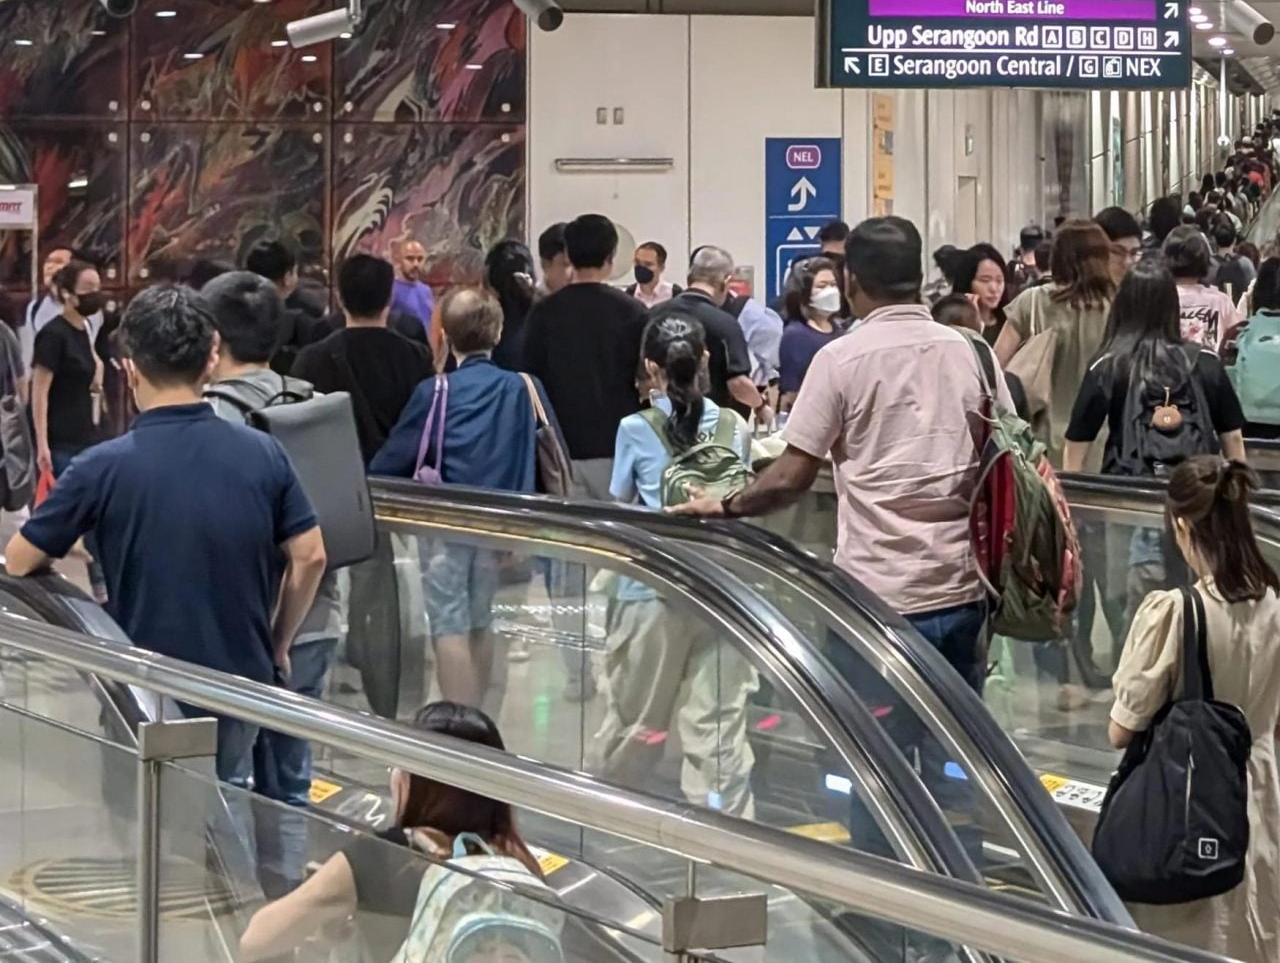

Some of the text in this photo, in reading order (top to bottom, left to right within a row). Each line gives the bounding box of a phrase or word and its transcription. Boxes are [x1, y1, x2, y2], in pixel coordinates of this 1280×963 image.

[965, 0, 1065, 15] North East Line
[867, 24, 908, 49] Upp
[911, 24, 1010, 49] Serangoon
[1015, 25, 1039, 47] Rd
[893, 55, 992, 80] Serangoon
[996, 55, 1061, 76] Central
[1126, 57, 1162, 77] NEX
[793, 151, 815, 163] NEL
